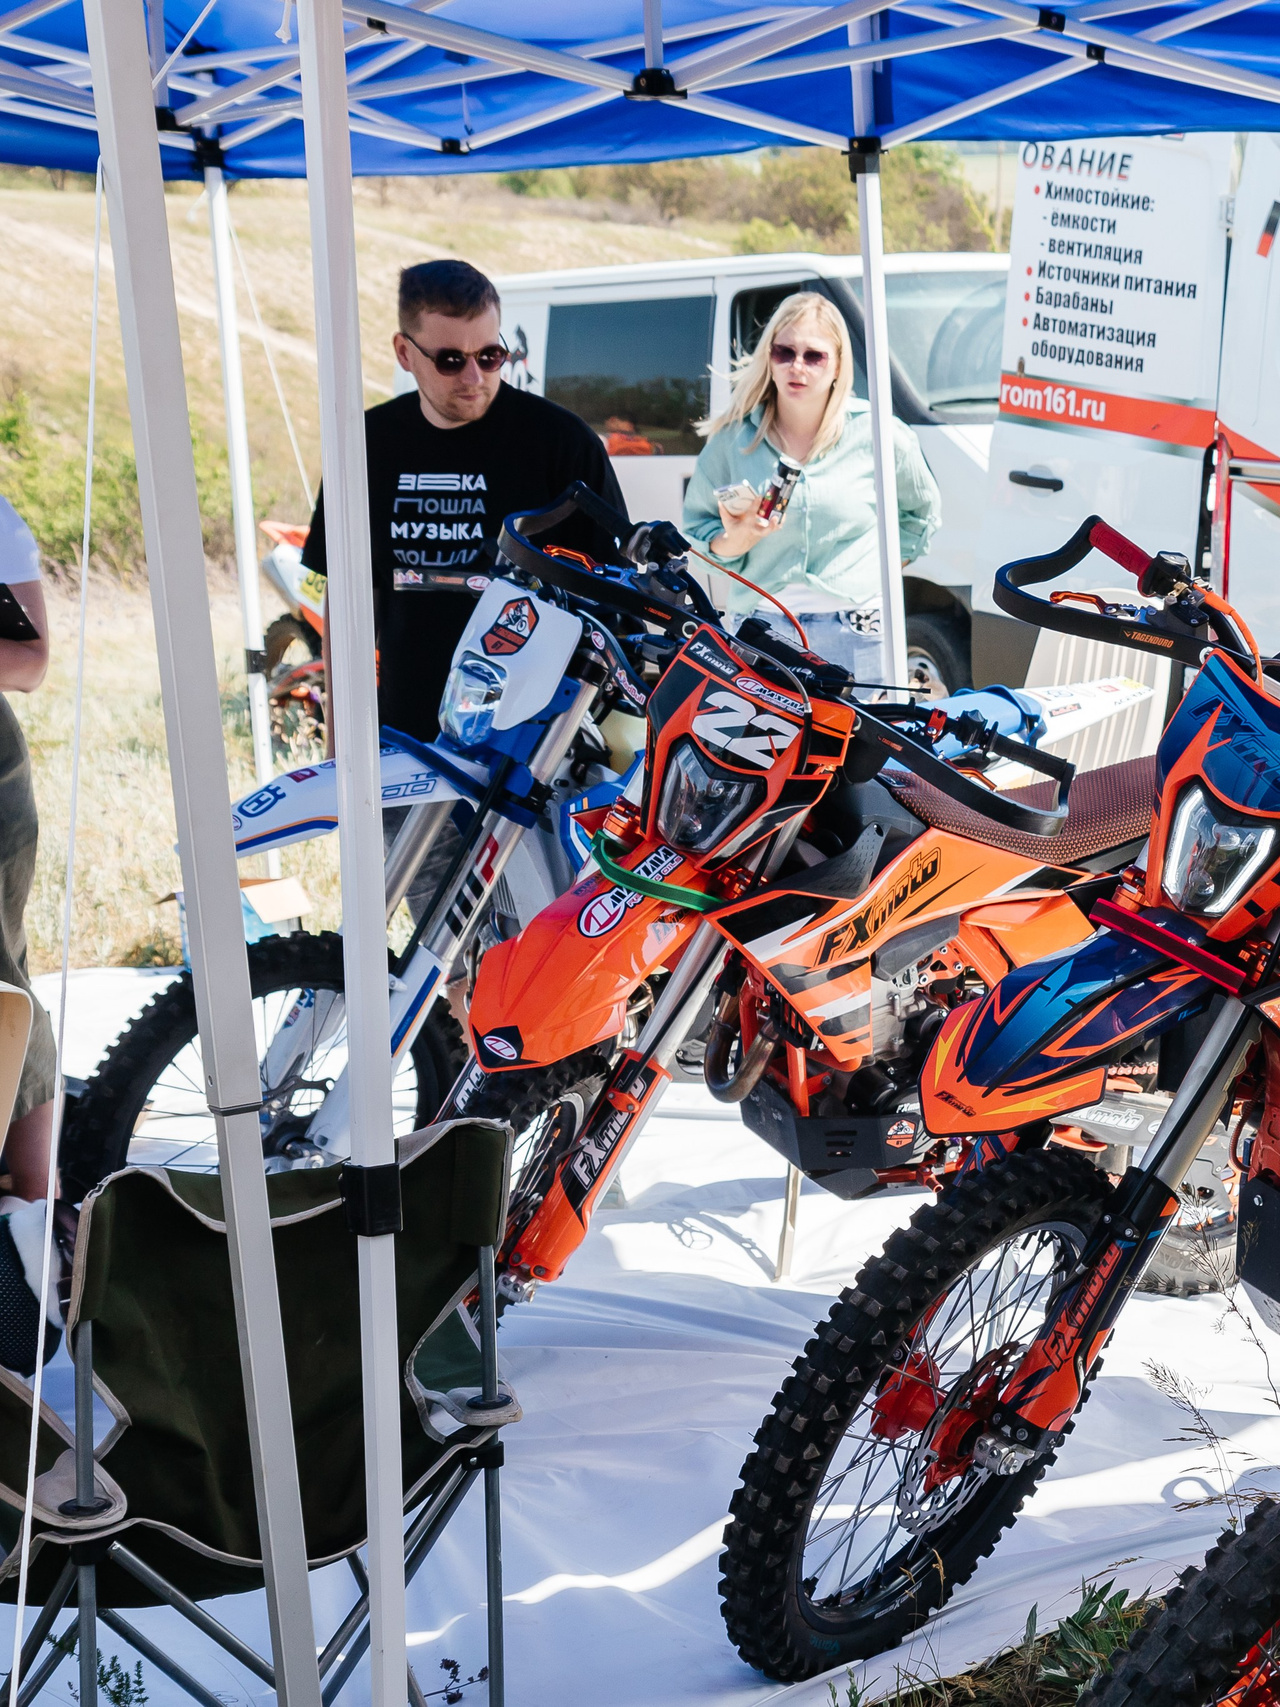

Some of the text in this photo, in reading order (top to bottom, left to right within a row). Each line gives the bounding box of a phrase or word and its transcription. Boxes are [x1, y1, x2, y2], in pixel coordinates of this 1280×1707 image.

[1022, 142, 1134, 181] ОВАНИЕ
[1044, 181, 1156, 213] Химостойкие:
[1051, 208, 1117, 235] ёмкости
[1048, 237, 1144, 266] вентиляция
[1037, 260, 1198, 301] Источники питания
[1035, 286, 1115, 316] Барабаны
[1033, 313, 1158, 349] Автоматизация
[1031, 339, 1145, 374] оборудования
[393, 498, 487, 515] ПОШЛА
[391, 521, 484, 541] МУЗЫКА
[1131, 631, 1175, 649] TAGENDURO
[692, 690, 803, 771] 22
[814, 846, 942, 968] FXmoto
